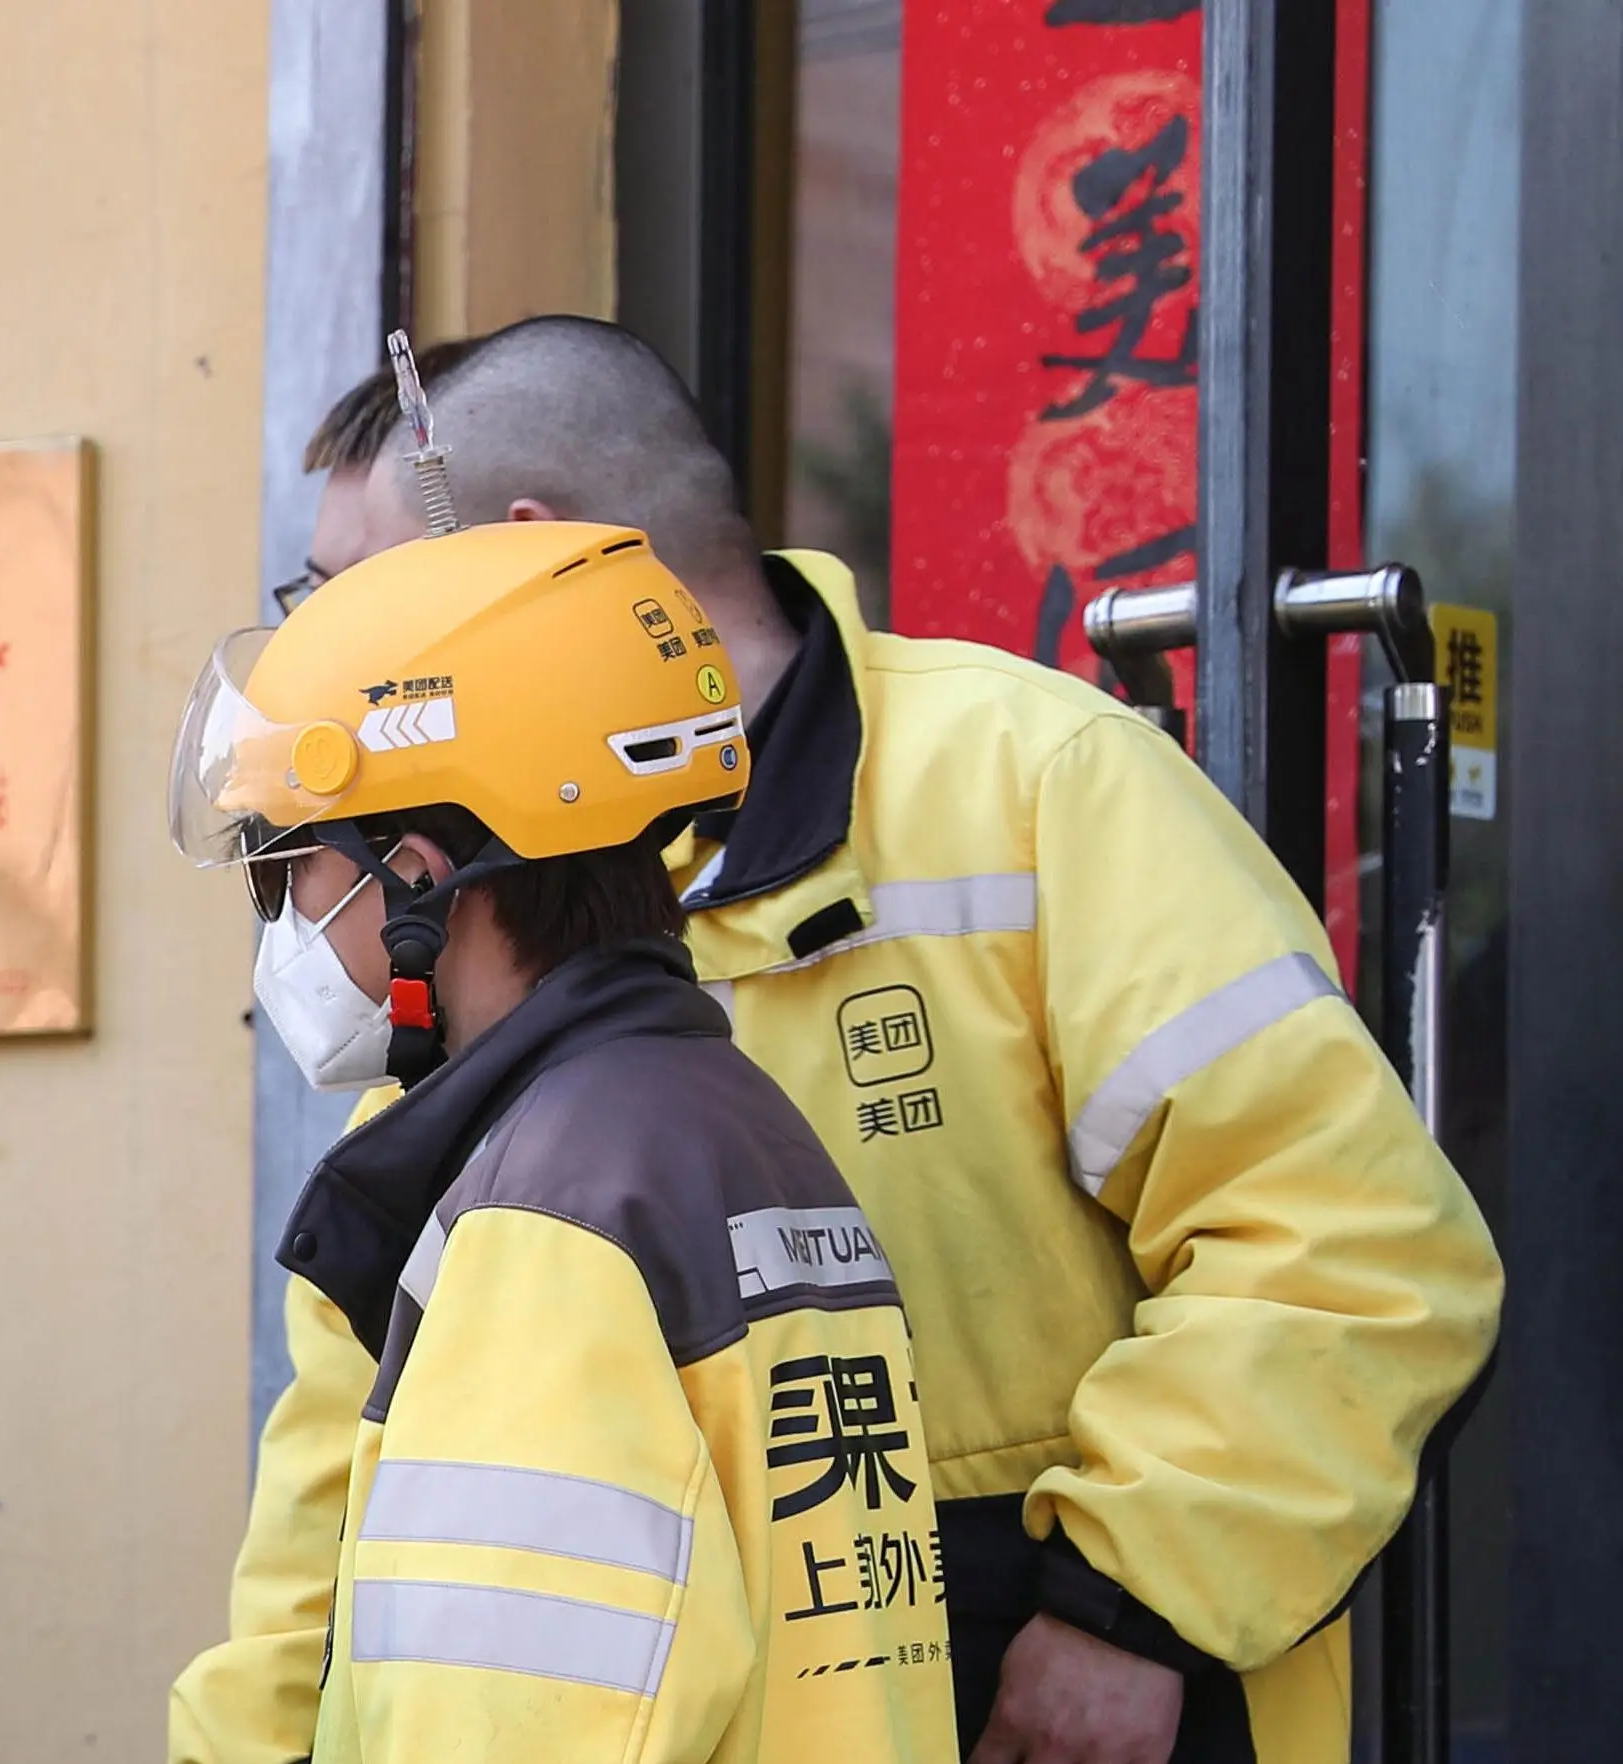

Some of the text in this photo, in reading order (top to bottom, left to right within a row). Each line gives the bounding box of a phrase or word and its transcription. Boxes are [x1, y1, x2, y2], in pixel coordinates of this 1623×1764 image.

[657, 636, 687, 662] 美团
[847, 1011, 923, 1061] 美团
[856, 1087, 944, 1144] 美团
[776, 1226, 883, 1267] MITUA
